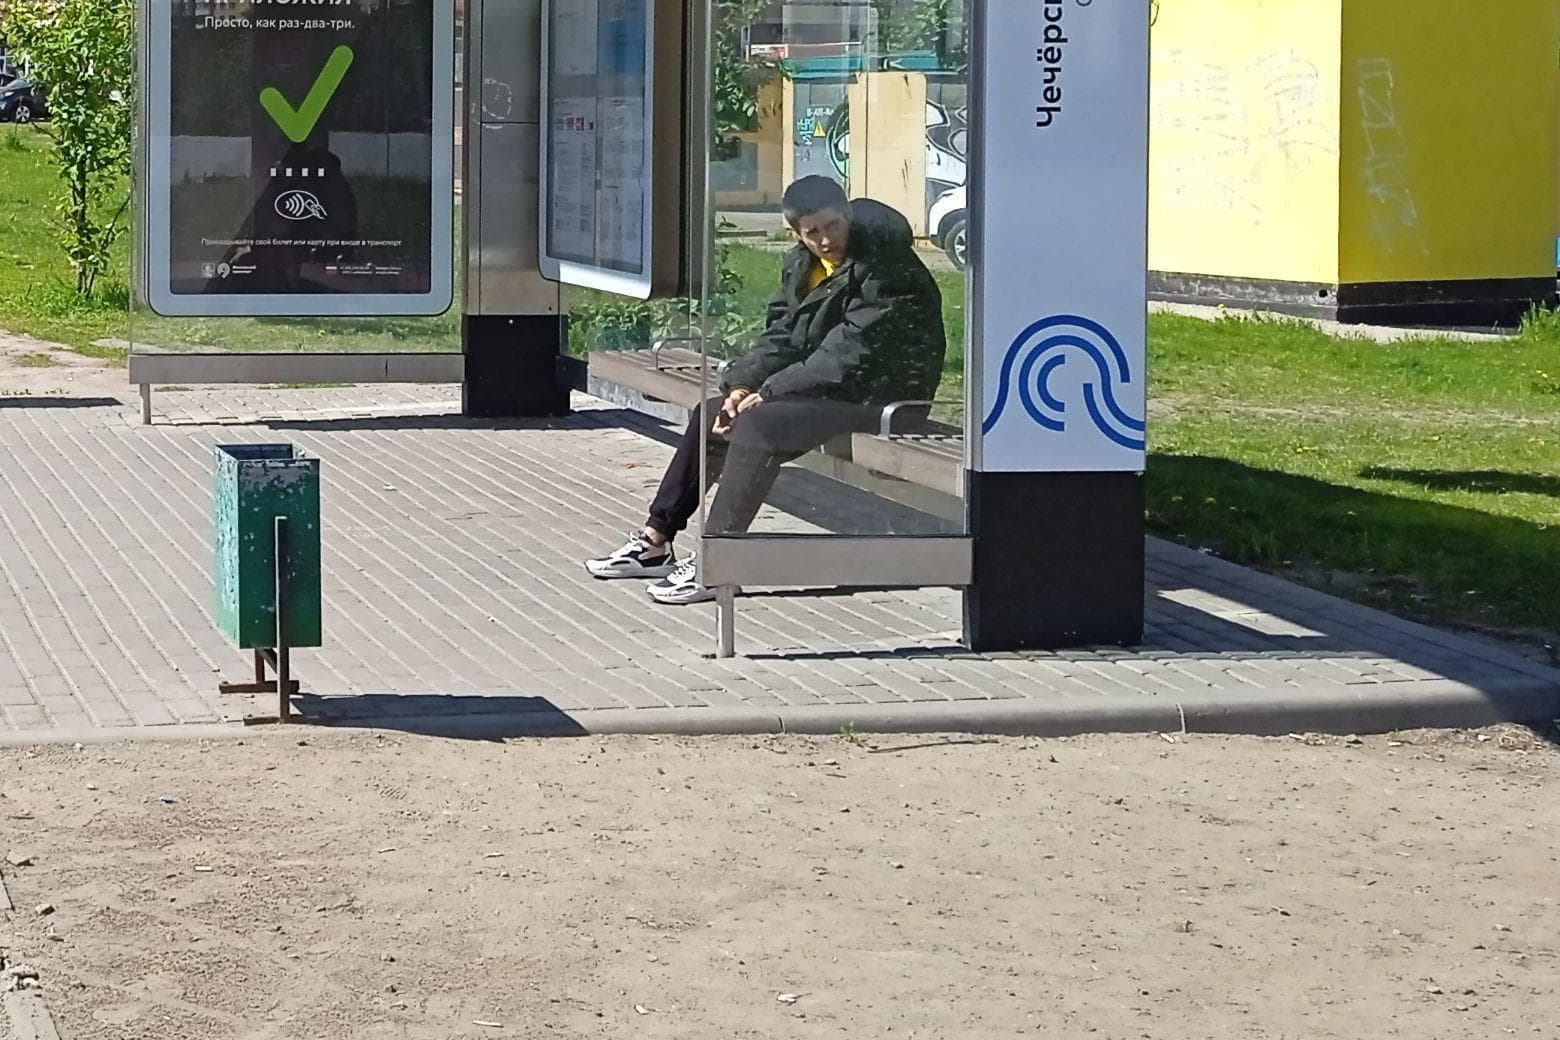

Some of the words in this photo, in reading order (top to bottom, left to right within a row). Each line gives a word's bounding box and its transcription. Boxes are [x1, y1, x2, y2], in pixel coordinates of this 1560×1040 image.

[204, 16, 253, 29] Просто,
[256, 19, 276, 28] как
[278, 19, 355, 31] раз-два-три.
